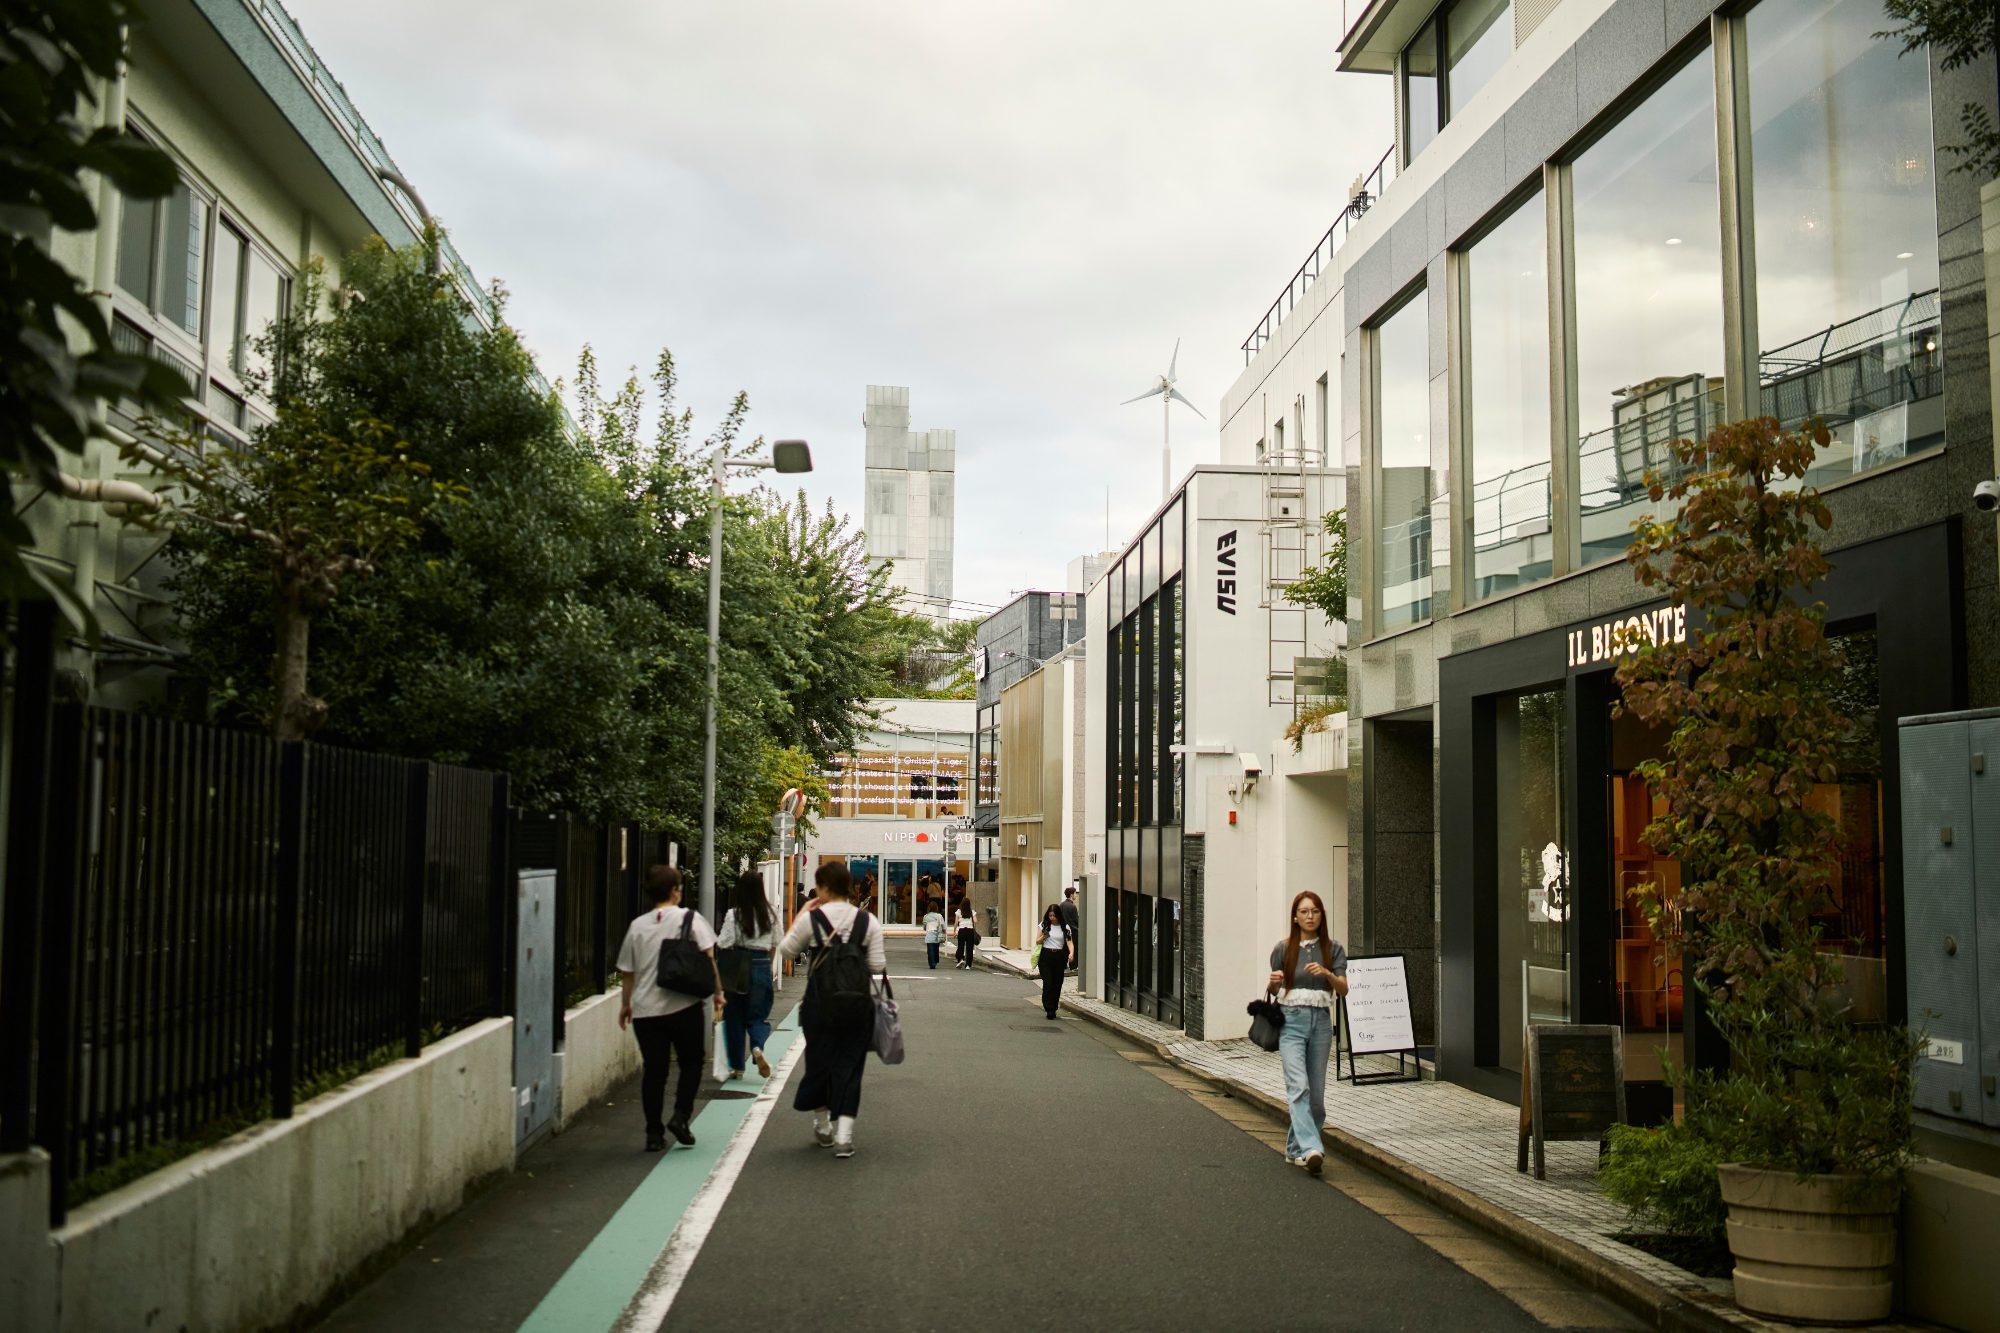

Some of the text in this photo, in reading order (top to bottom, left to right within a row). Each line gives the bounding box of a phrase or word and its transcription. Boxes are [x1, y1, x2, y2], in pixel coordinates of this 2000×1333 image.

[1217, 529, 1237, 616] EVISU
[1568, 603, 1686, 667] IL BISONTE
[942, 757, 963, 767] Tiger
[900, 769, 934, 778] NIPPON
[936, 770, 963, 779] MADE
[864, 781, 902, 790] showcae
[905, 782, 918, 791] the
[953, 783, 963, 791] of
